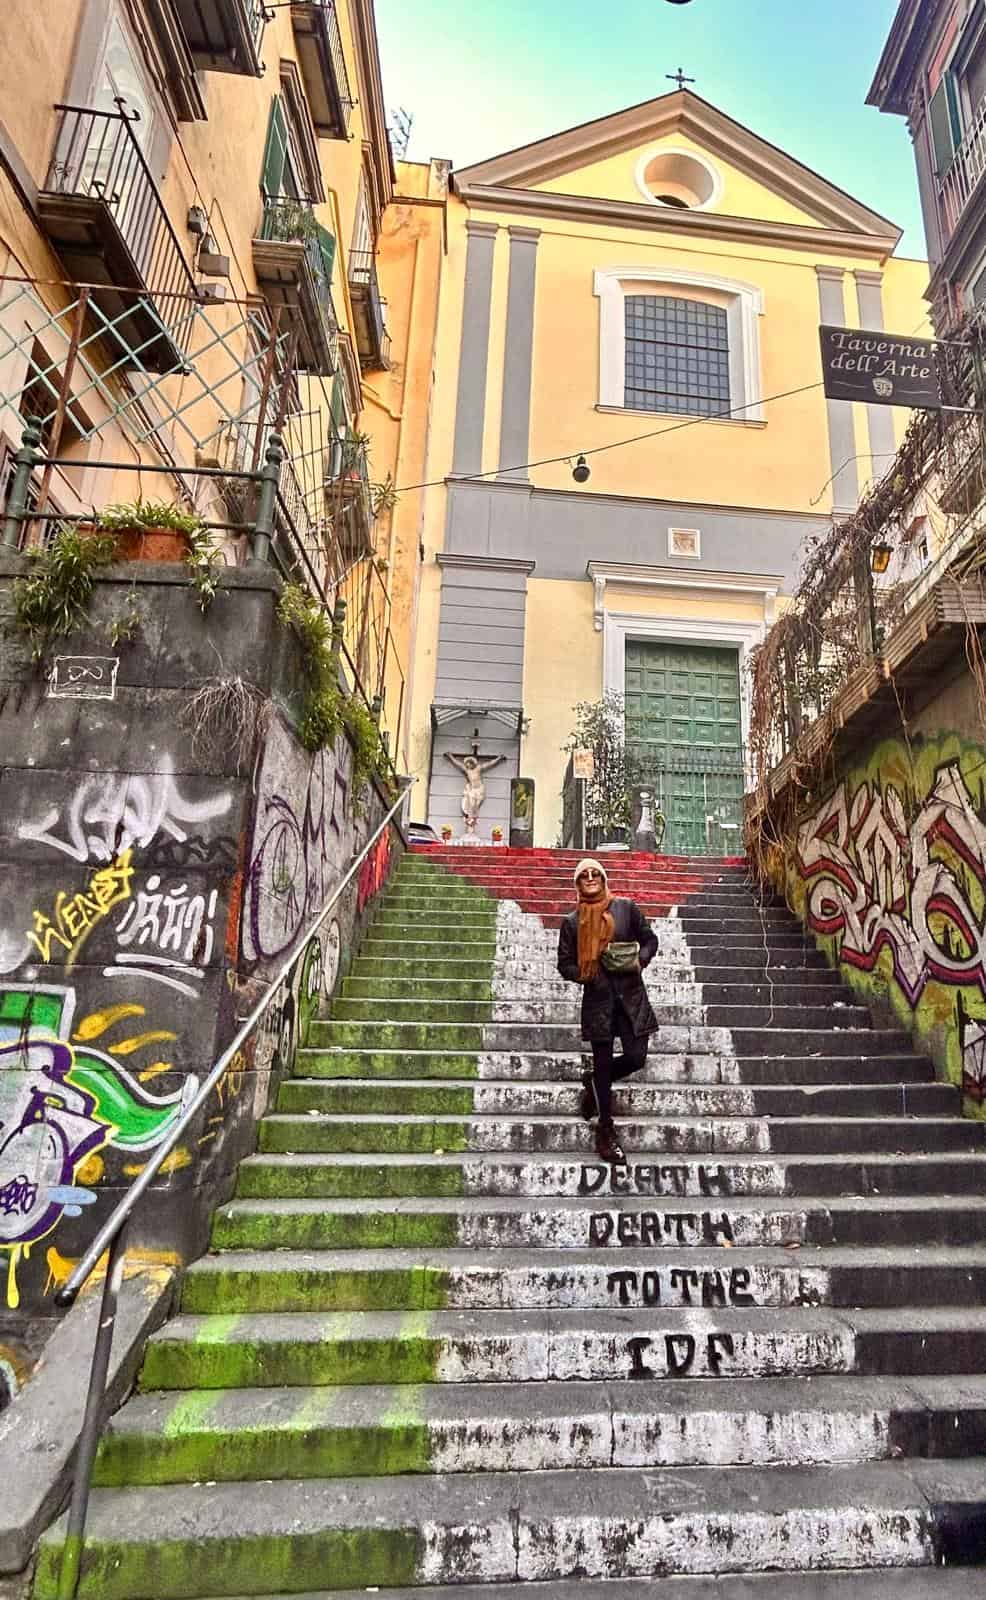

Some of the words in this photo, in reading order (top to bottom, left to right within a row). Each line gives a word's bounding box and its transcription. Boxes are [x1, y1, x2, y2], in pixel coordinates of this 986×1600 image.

[830, 331, 928, 358] Taverna
[577, 1163, 732, 1194] DEATH
[588, 1211, 735, 1245] DEATH
[606, 1270, 661, 1304] TO
[626, 1332, 734, 1379] IDF
